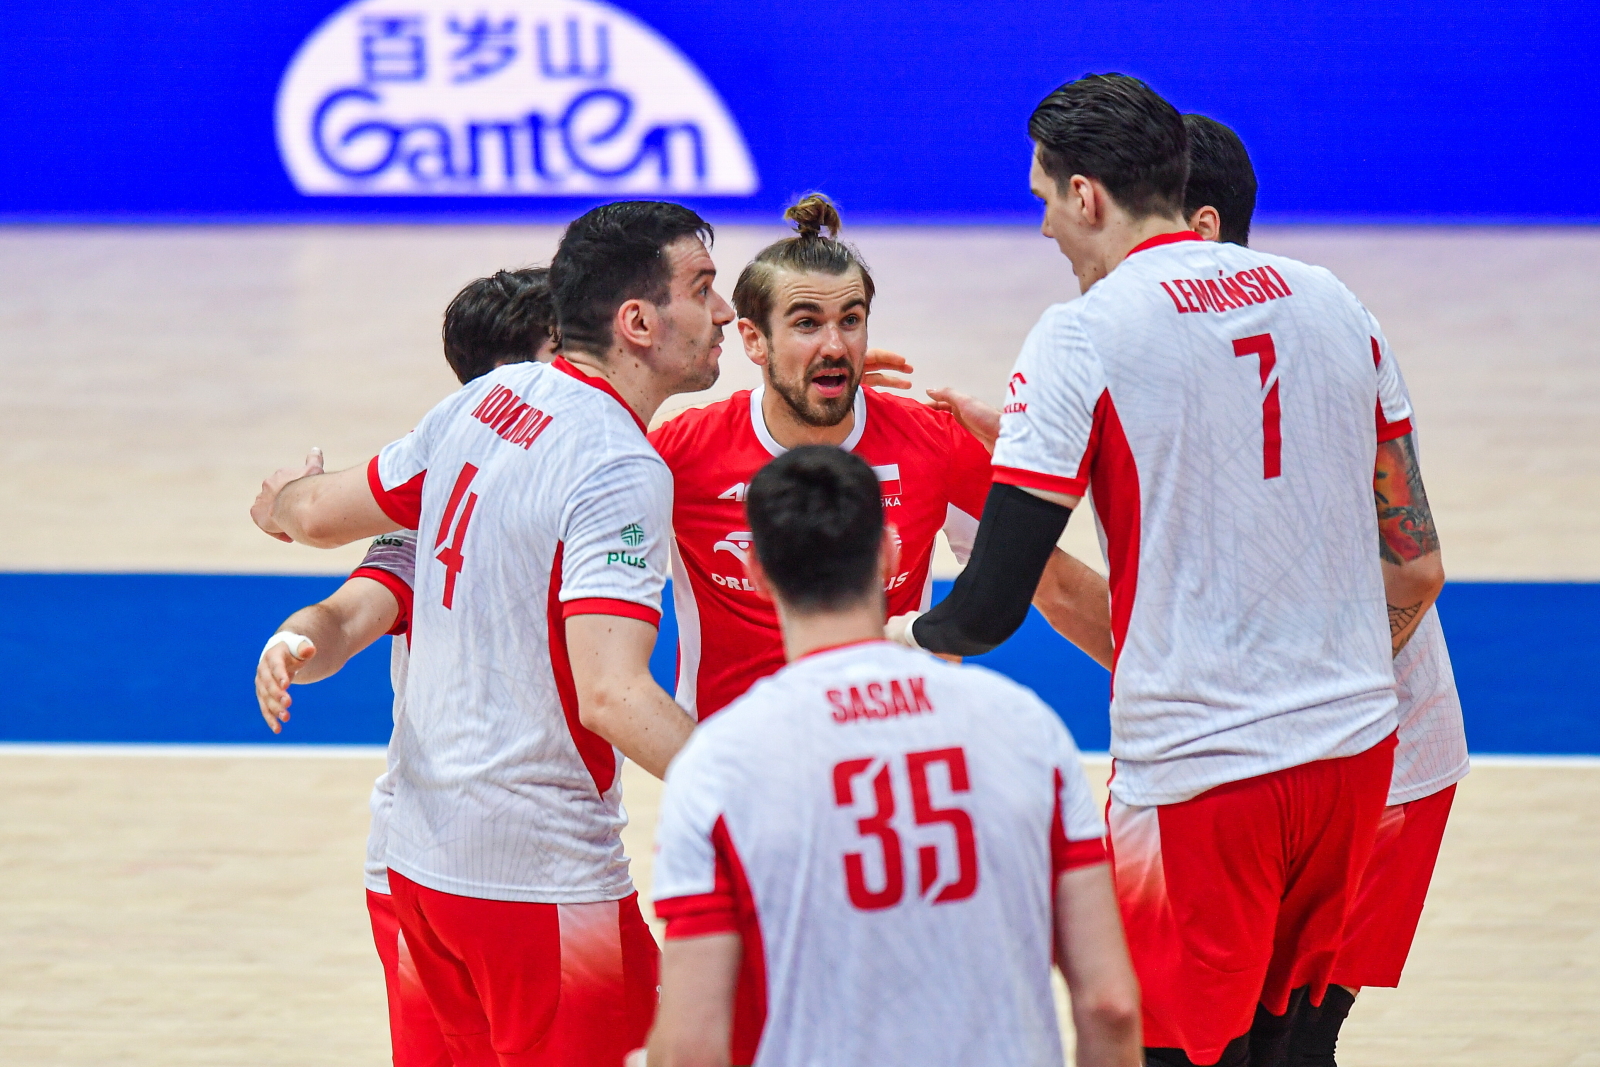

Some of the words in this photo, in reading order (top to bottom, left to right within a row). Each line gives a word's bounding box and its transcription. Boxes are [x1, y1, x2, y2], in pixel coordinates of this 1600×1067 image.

[358, 14, 611, 85] 百岁山
[1159, 265, 1293, 314] LEMAŃSKI
[1232, 332, 1282, 480] 7
[434, 461, 479, 611] 4
[607, 550, 647, 569] plus
[711, 572, 756, 592] ORL
[826, 677, 933, 724] SASAK
[833, 746, 980, 912] 35
